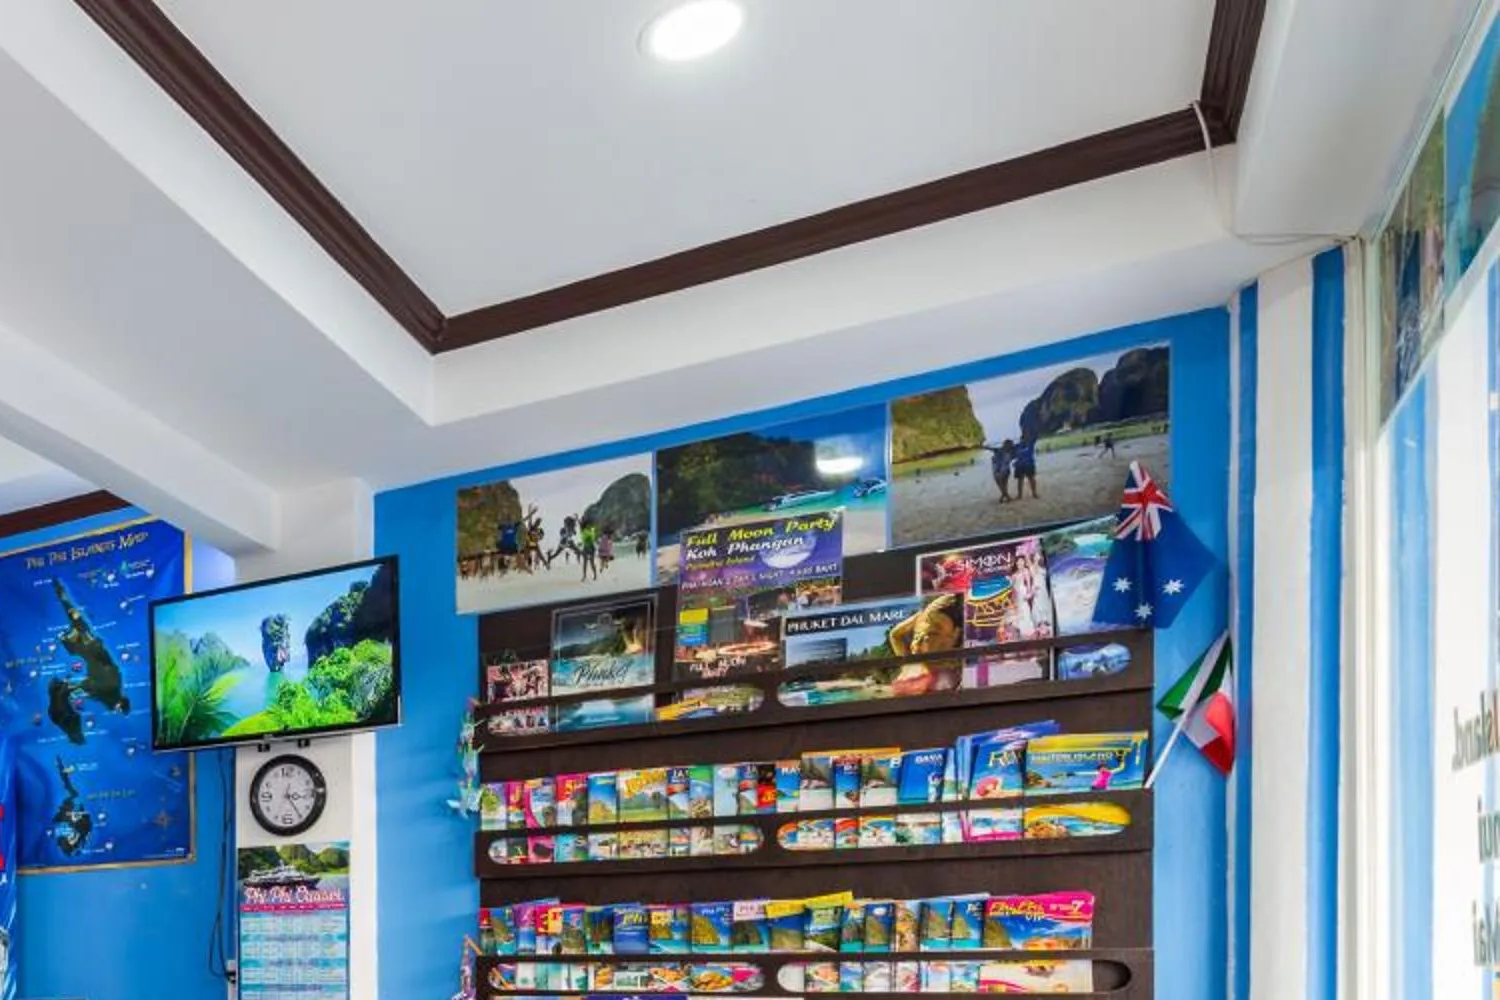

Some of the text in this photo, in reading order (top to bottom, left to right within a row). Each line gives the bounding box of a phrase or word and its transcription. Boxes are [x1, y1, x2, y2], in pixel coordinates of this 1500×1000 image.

[728, 527, 773, 541] Moon
[785, 518, 835, 533] Party
[686, 537, 803, 561] Koh Phangan
[787, 618, 836, 633] PHUKET
[841, 614, 864, 627] DAL
